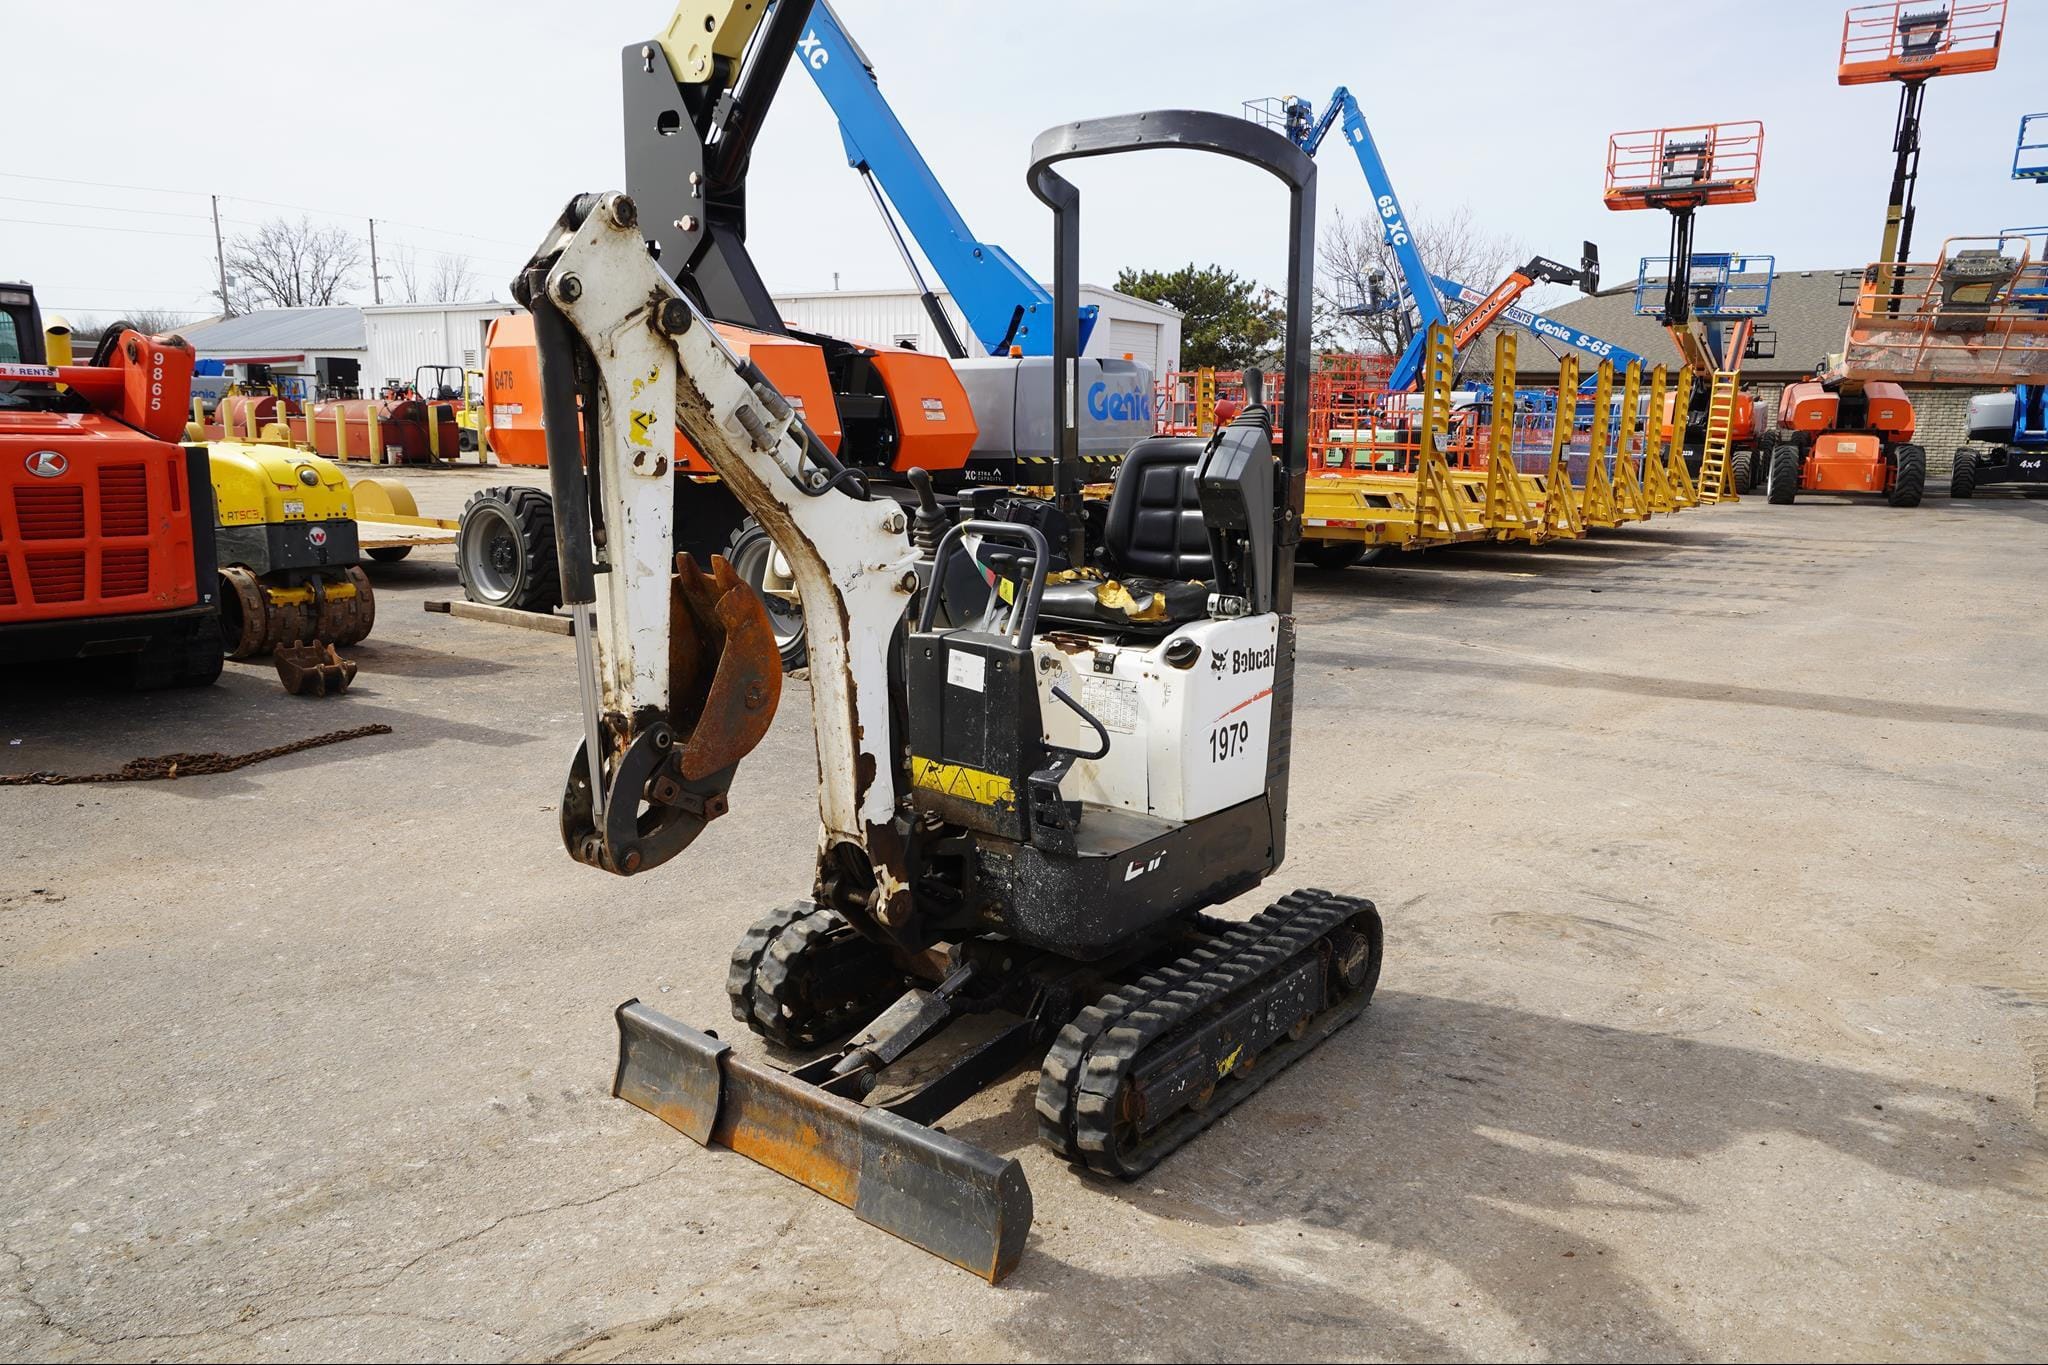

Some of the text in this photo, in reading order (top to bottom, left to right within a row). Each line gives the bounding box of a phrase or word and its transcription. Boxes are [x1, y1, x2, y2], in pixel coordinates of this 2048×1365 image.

[797, 29, 829, 70] XC
[1378, 195, 1408, 246] 65 XC
[1507, 308, 1532, 324] RENTS
[1535, 318, 1570, 341] Genie
[1576, 335, 1613, 356] S-65
[19, 368, 54, 376] RENTS
[151, 352, 165, 410] 9865
[494, 370, 513, 390] 6476
[964, 470, 976, 480] XC
[2019, 460, 2041, 469] 4x4
[1232, 644, 1274, 675] Bobcat
